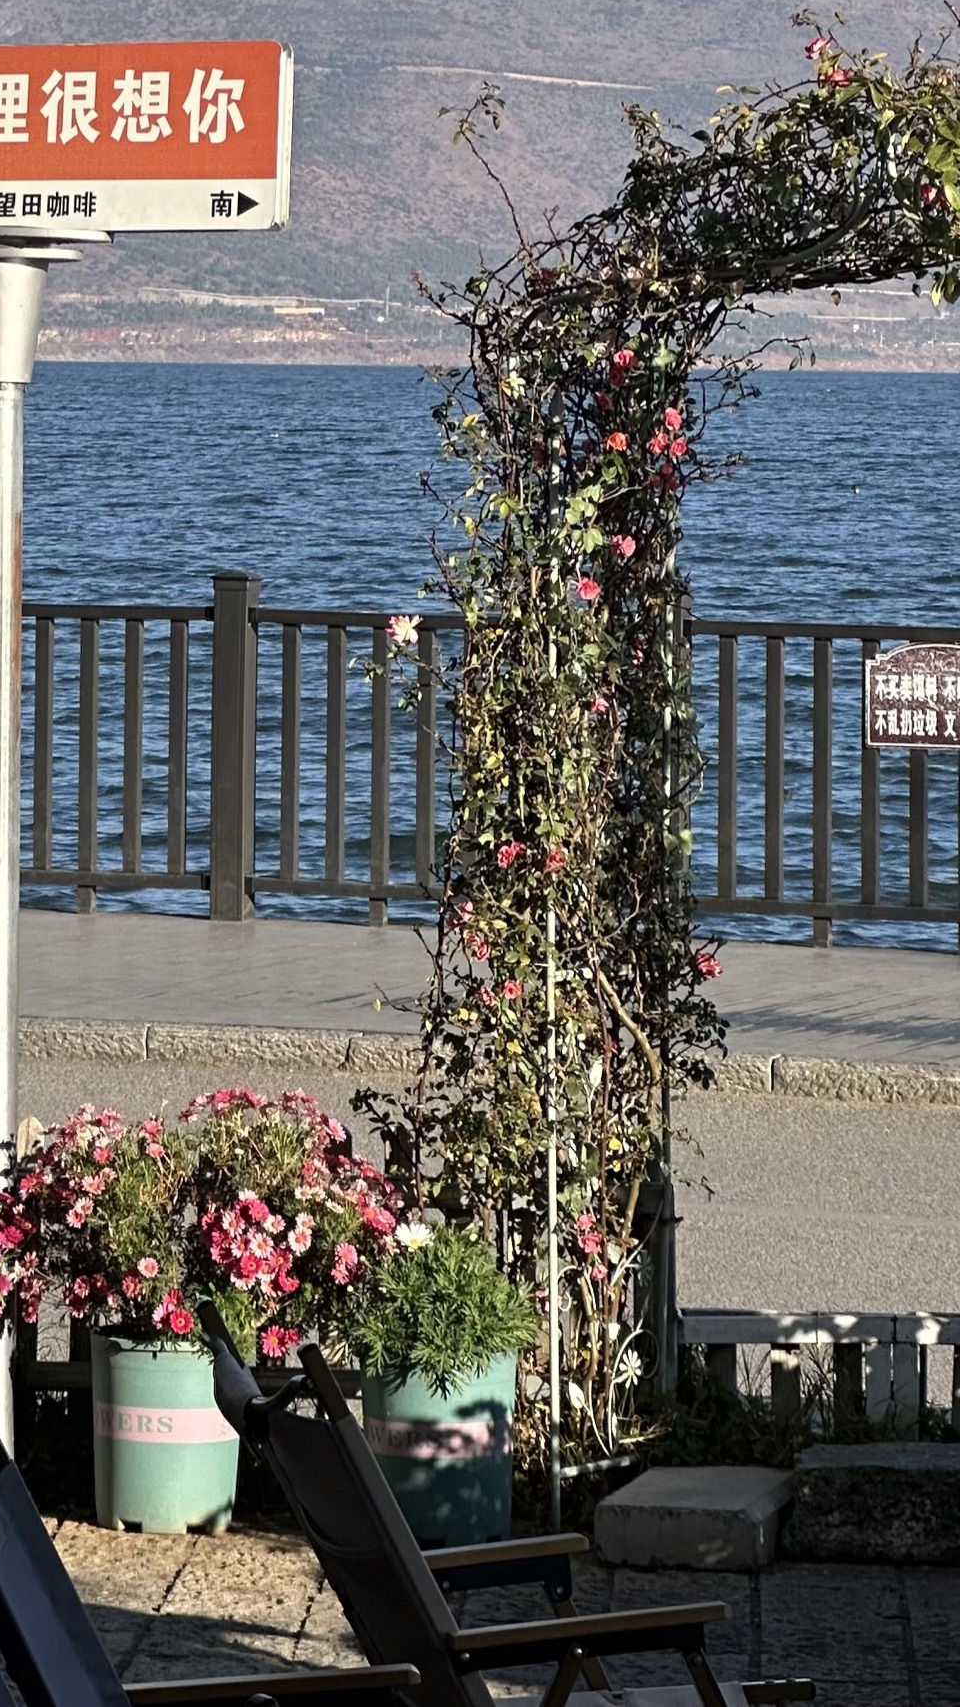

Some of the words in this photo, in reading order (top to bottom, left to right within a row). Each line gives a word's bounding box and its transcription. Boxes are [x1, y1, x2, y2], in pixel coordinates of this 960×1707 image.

[211, 191, 234, 217] 南
[943, 676, 960, 703] 不
[875, 708, 938, 736] 不乱扔垃圾
[96, 1408, 173, 1434] WERS
